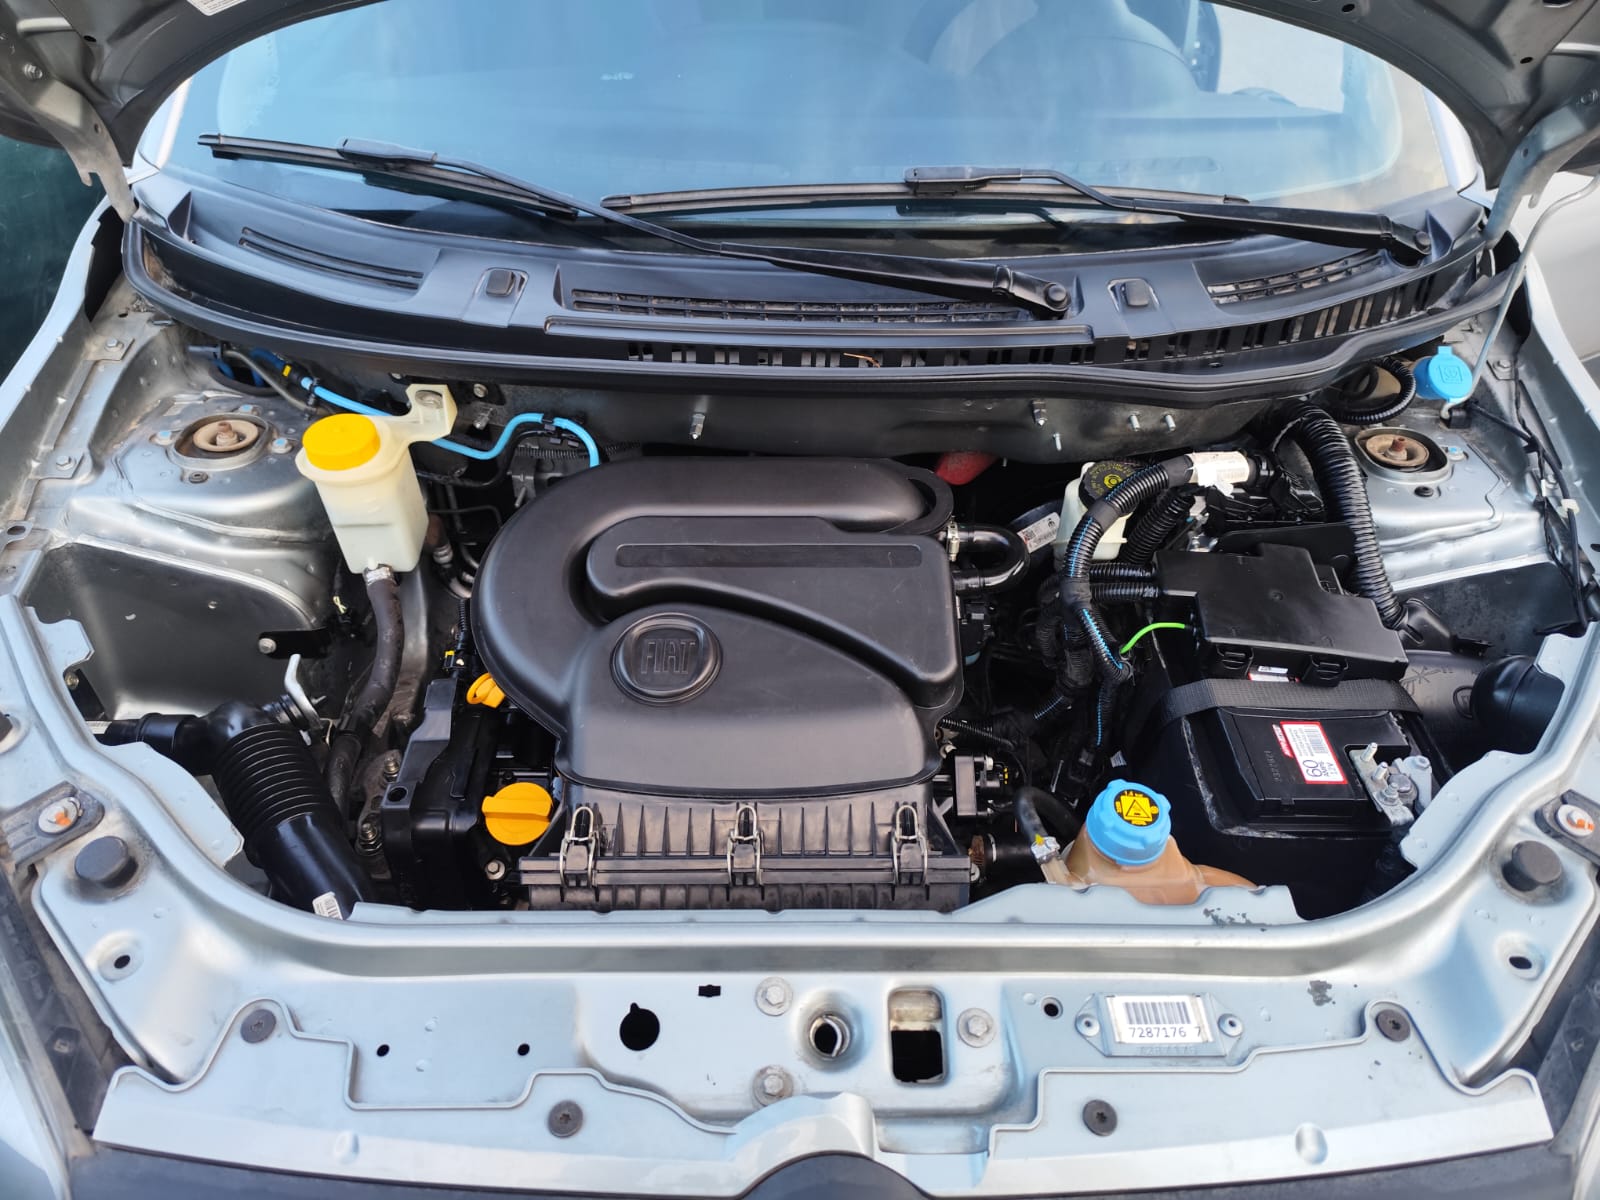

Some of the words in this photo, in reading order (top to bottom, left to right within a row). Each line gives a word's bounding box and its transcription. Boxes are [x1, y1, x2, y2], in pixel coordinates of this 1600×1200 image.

[640, 638, 696, 675] FIAT
[1302, 759, 1324, 778] 60
[1128, 1026, 1188, 1039] 7287176
[1193, 1025, 1201, 1037] 7
